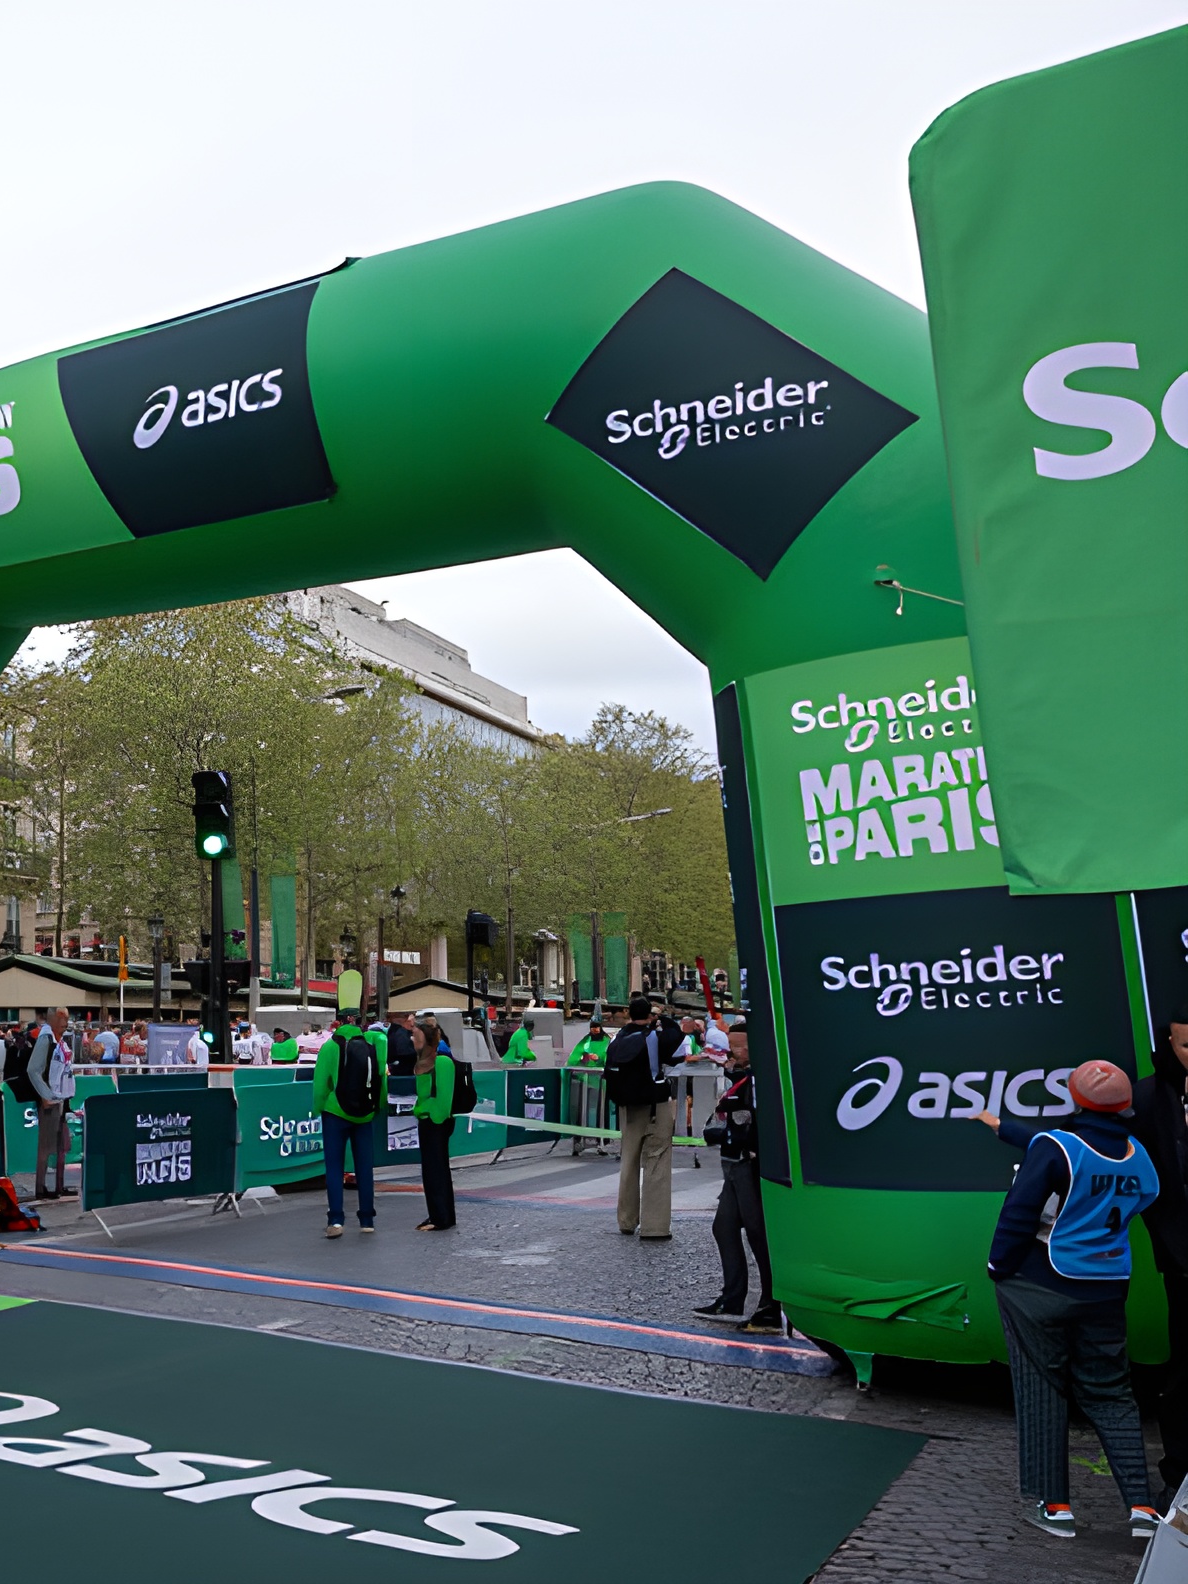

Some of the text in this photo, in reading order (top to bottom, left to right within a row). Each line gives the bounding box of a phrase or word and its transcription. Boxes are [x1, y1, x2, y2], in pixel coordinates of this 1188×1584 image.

[606, 377, 829, 443] Schneider
[791, 675, 977, 734] Schneid
[799, 746, 988, 821] MARAT
[821, 945, 1064, 990] Schneider
